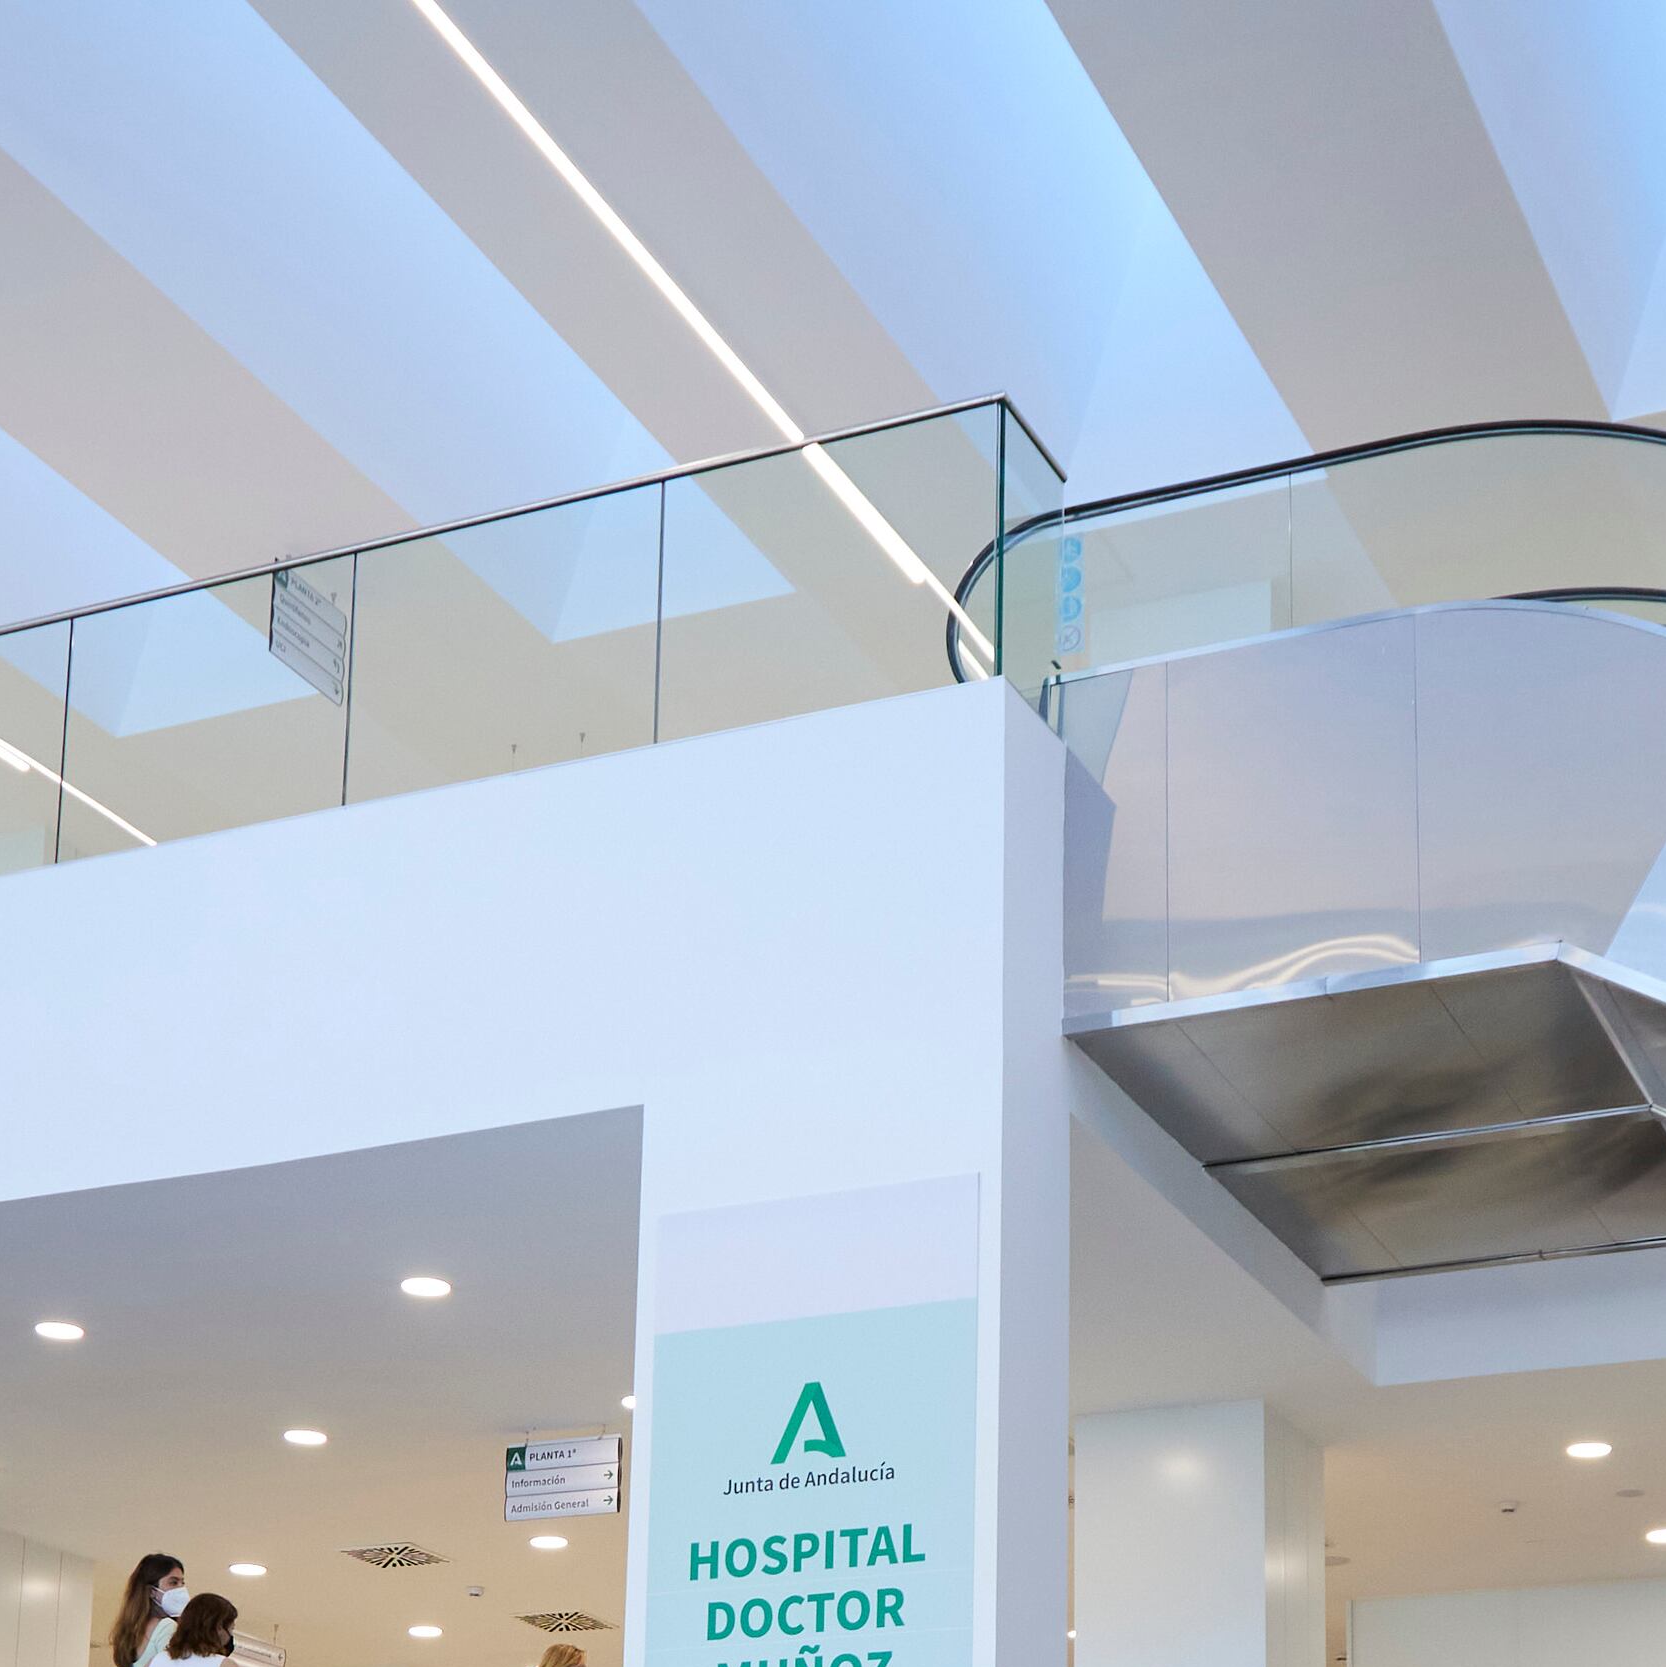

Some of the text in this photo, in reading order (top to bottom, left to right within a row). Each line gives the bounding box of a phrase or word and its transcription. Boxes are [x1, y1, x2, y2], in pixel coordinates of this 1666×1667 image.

[529, 1450, 565, 1462] PLANTA
[511, 1474, 566, 1489] Información
[723, 1461, 895, 1496] Junta de Andalucía
[511, 1498, 589, 1514] Admisión General
[689, 1523, 926, 1581] HOSPITAL
[706, 1587, 906, 1641] DOCTOR
